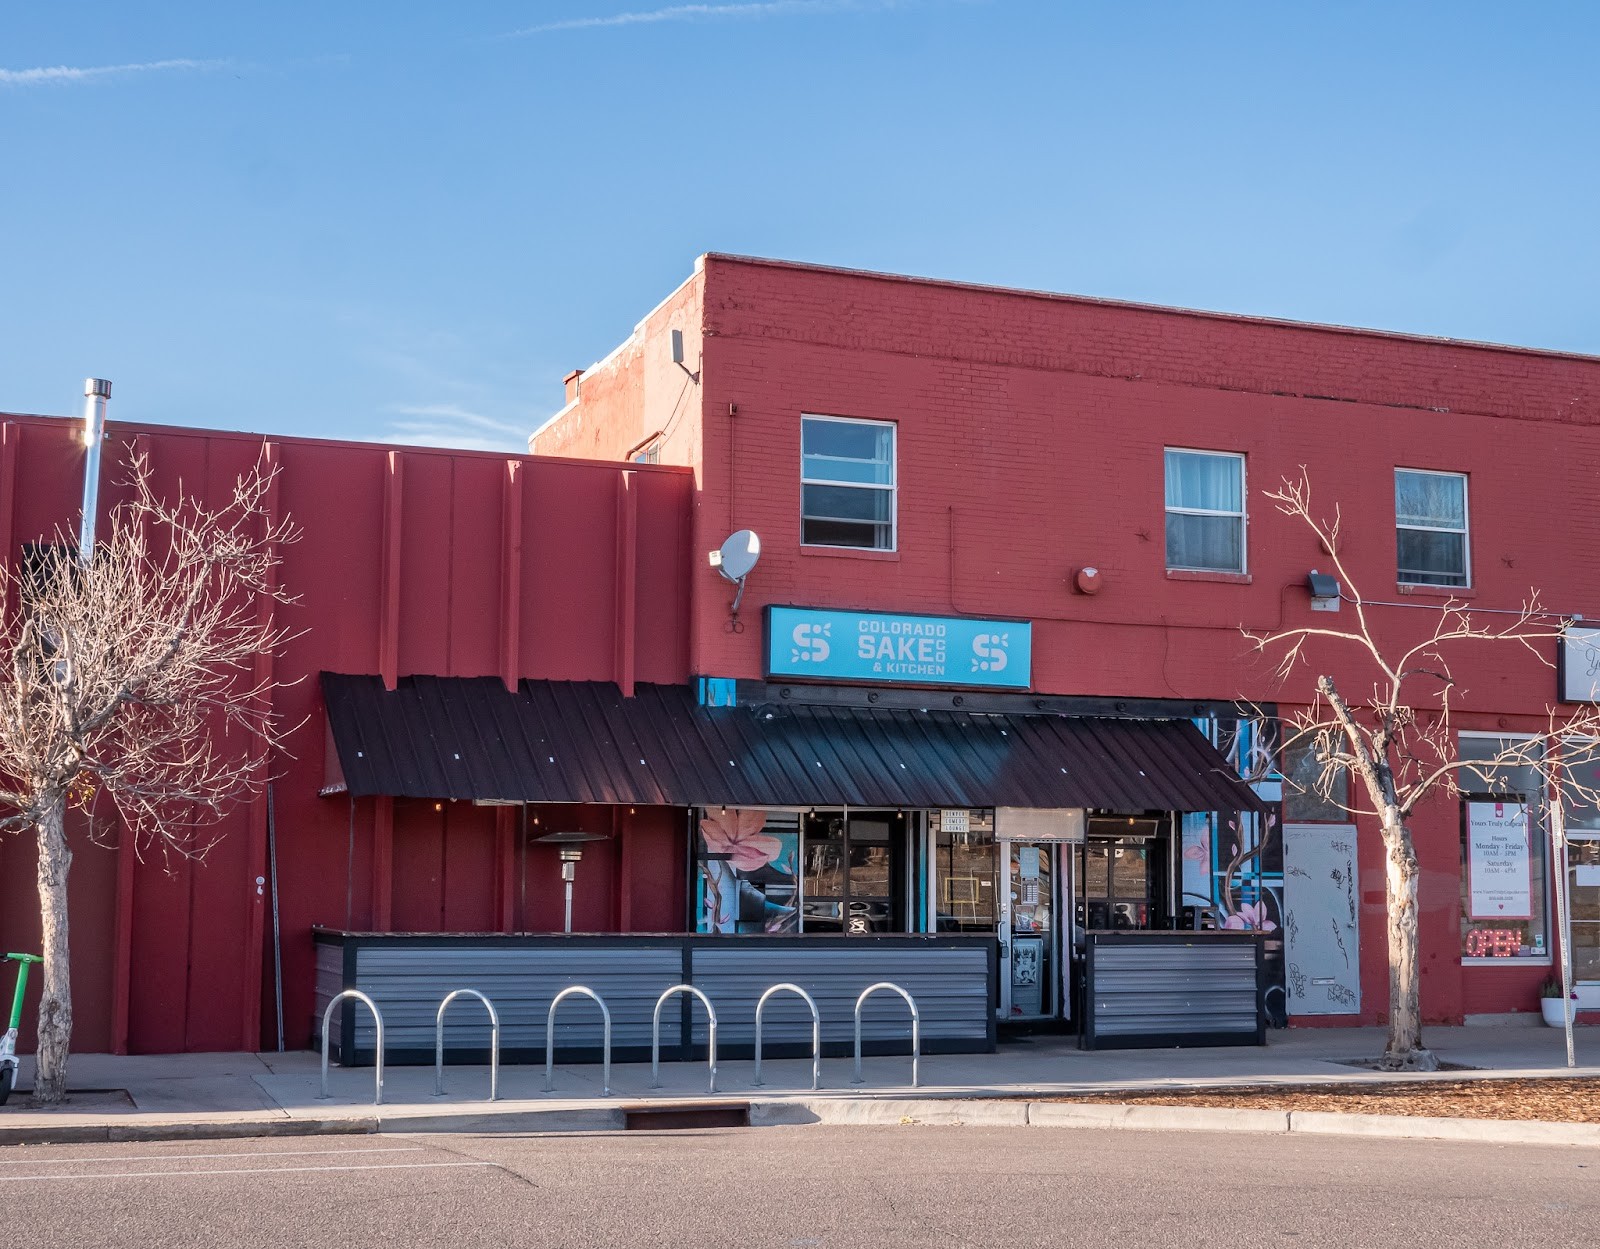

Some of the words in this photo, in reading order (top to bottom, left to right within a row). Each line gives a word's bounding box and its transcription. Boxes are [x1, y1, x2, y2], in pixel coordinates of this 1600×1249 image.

[858, 620, 946, 637] COLORADO
[858, 635, 935, 662] SAKE
[935, 639, 946, 662] CO
[873, 661, 882, 672] &
[886, 662, 945, 675] KITCHEN
[1488, 820, 1503, 828] Truly
[1505, 843, 1524, 851] Friday
[1466, 928, 1522, 957] OPEN
